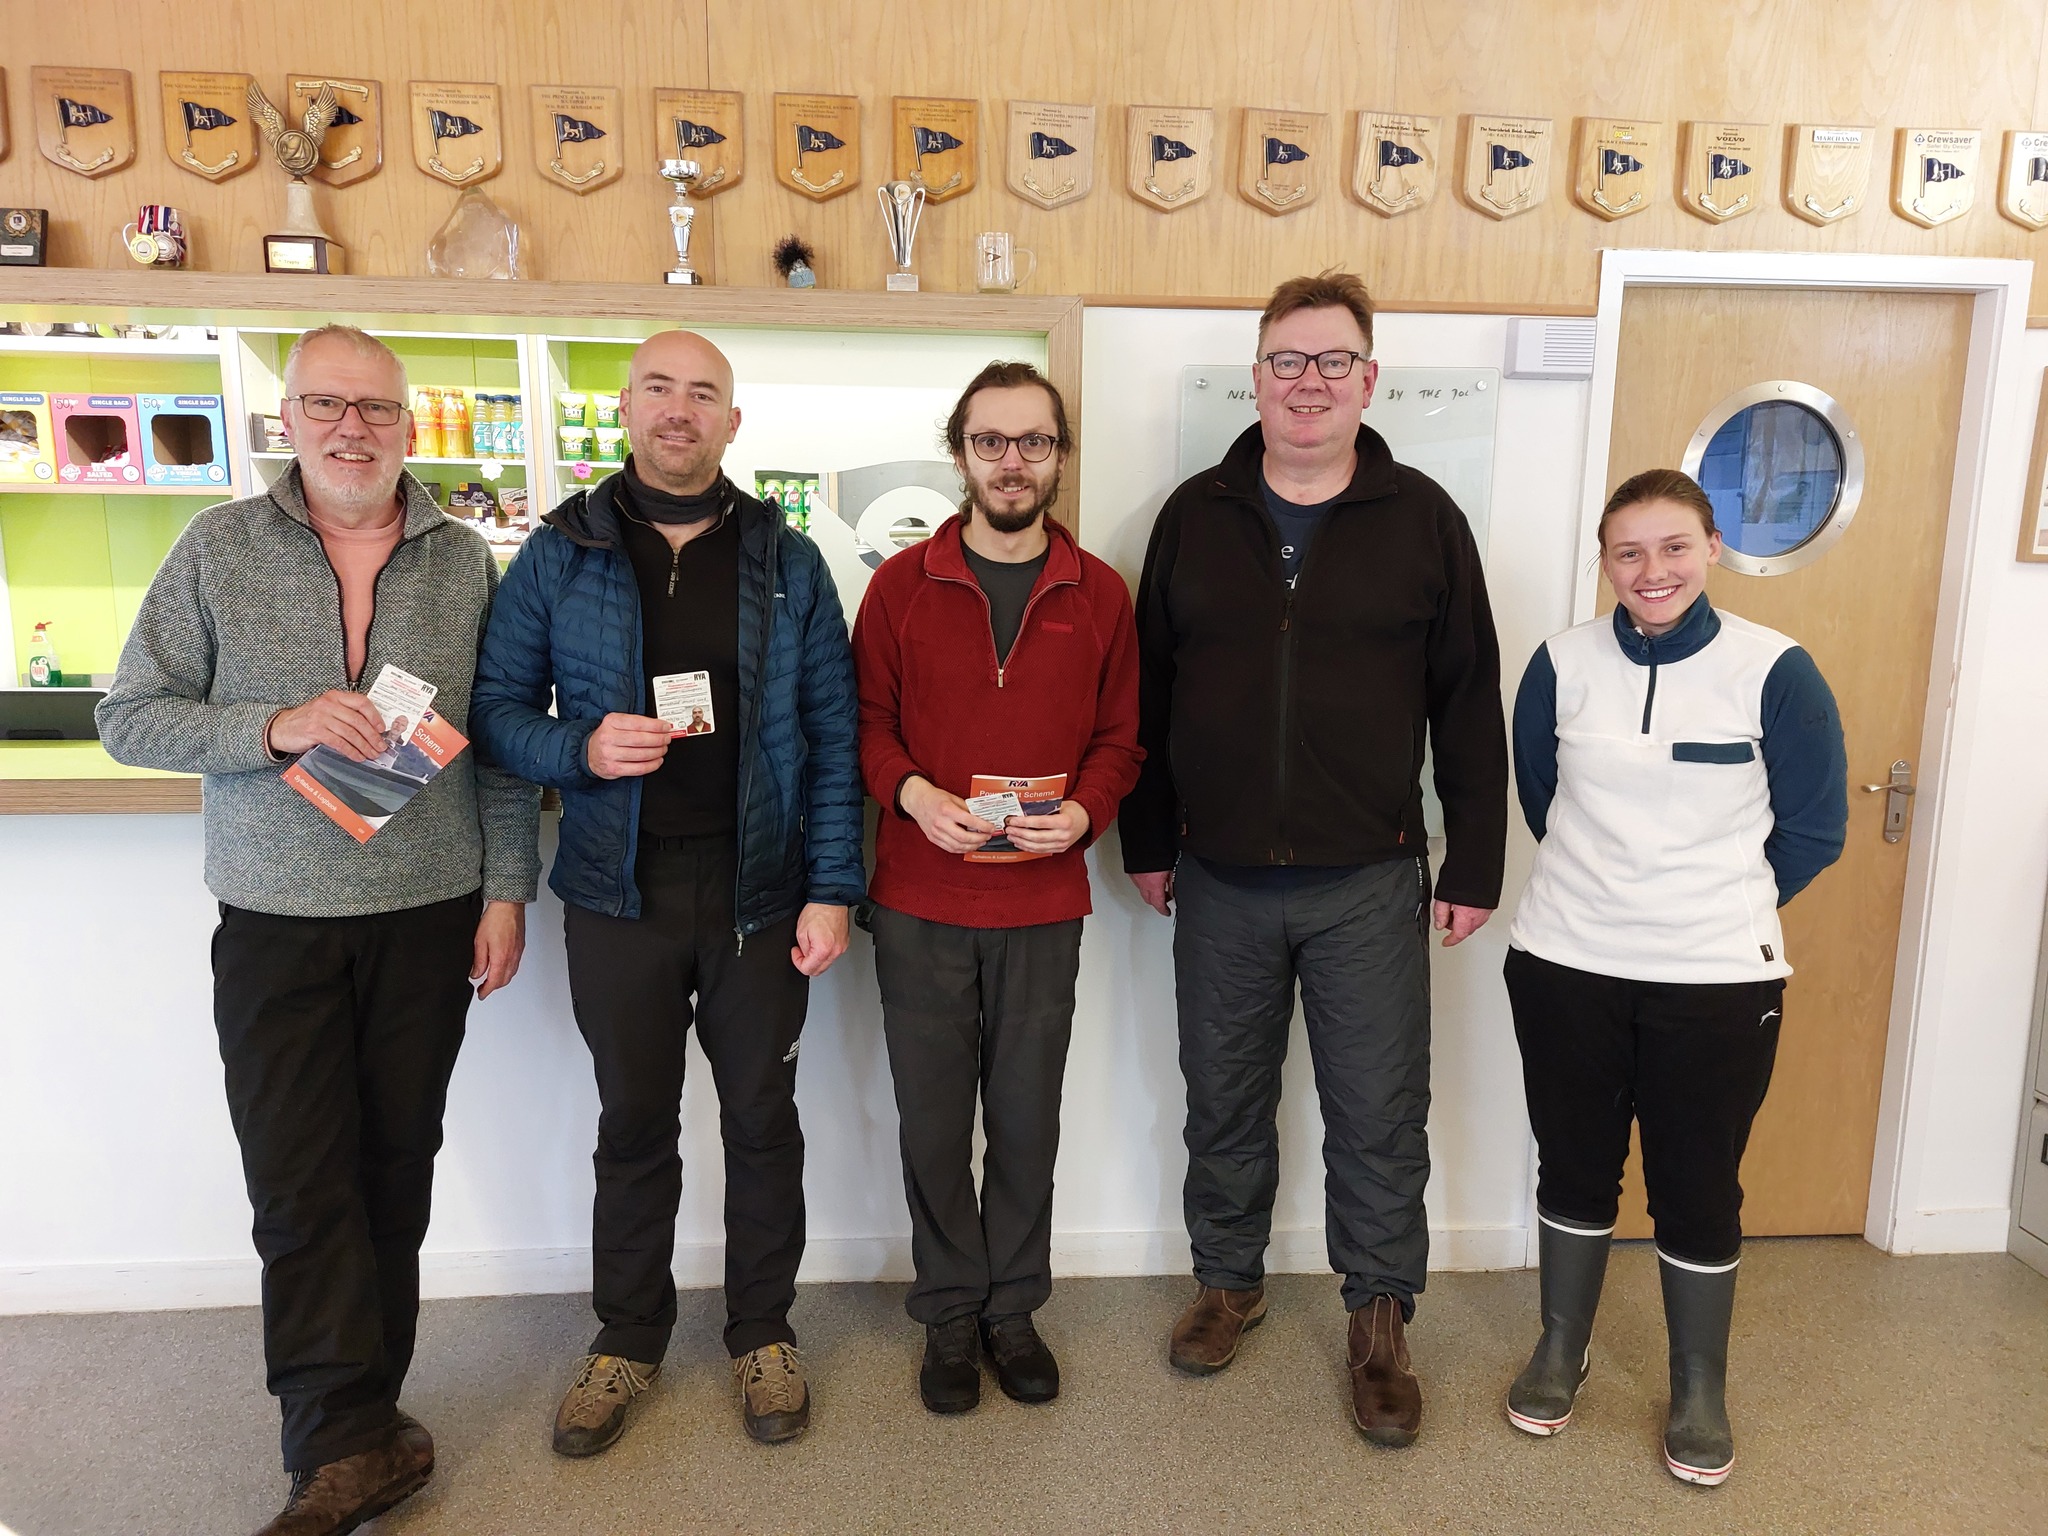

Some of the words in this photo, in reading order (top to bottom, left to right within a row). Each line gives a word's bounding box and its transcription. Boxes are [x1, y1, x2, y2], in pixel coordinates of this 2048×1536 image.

[1927, 135, 1973, 144] Crewsaver
[1388, 389, 1404, 400] BY
[1419, 390, 1442, 399] THE
[694, 673, 706, 681] RYA
[421, 684, 434, 695] RYA
[414, 728, 444, 756] Scheme
[294, 774, 314, 793] Syllabus
[1024, 790, 1055, 798] Scheme
